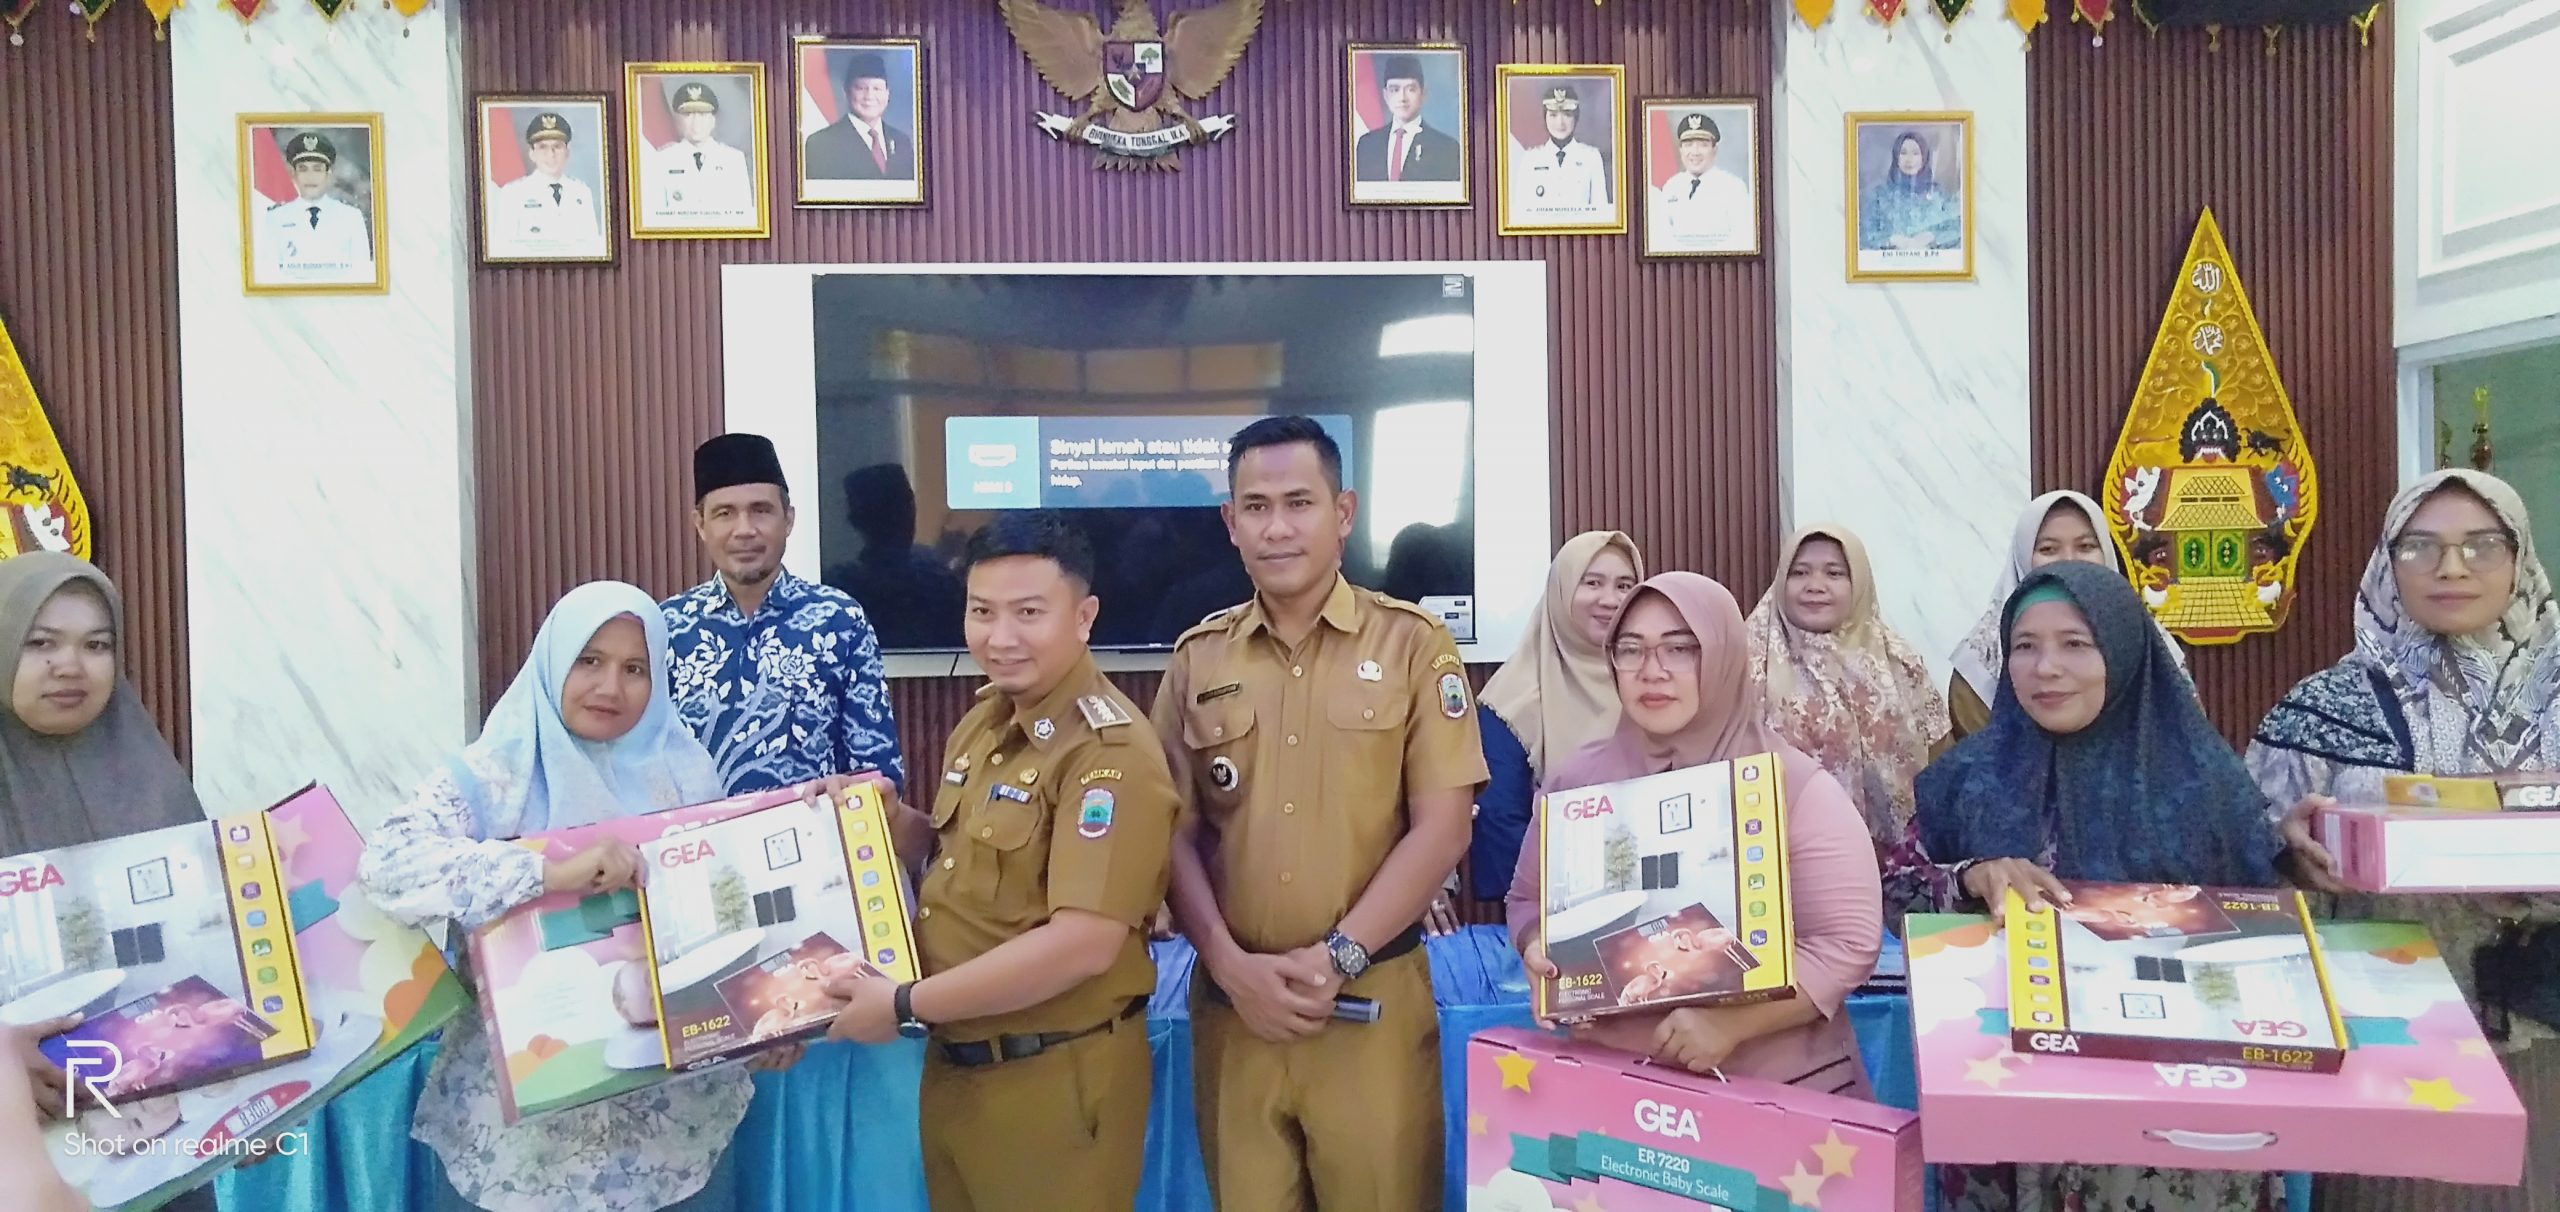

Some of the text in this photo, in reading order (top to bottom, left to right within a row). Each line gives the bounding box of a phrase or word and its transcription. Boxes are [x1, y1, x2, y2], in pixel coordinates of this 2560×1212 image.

[1050, 438, 1096, 459] Sinyal
[1098, 437, 1145, 455] lemah
[1147, 438, 1181, 455] atau
[1182, 437, 1220, 455] tidak
[1563, 795, 1614, 822] GEA
[659, 839, 716, 868] GEA
[0, 864, 65, 897] GEA
[1559, 974, 1604, 990] EB-1622
[681, 1014, 732, 1038] EB-1622
[2232, 1019, 2308, 1039] GEA
[2029, 1032, 2080, 1054] GEA
[2243, 1046, 2314, 1065] EB-1622
[2152, 1062, 2248, 1090] GEA
[1633, 1098, 1701, 1143] GEA
[1638, 1147, 1691, 1174] ER 7220
[1601, 1154, 1730, 1202] Electronic Baby Scale
